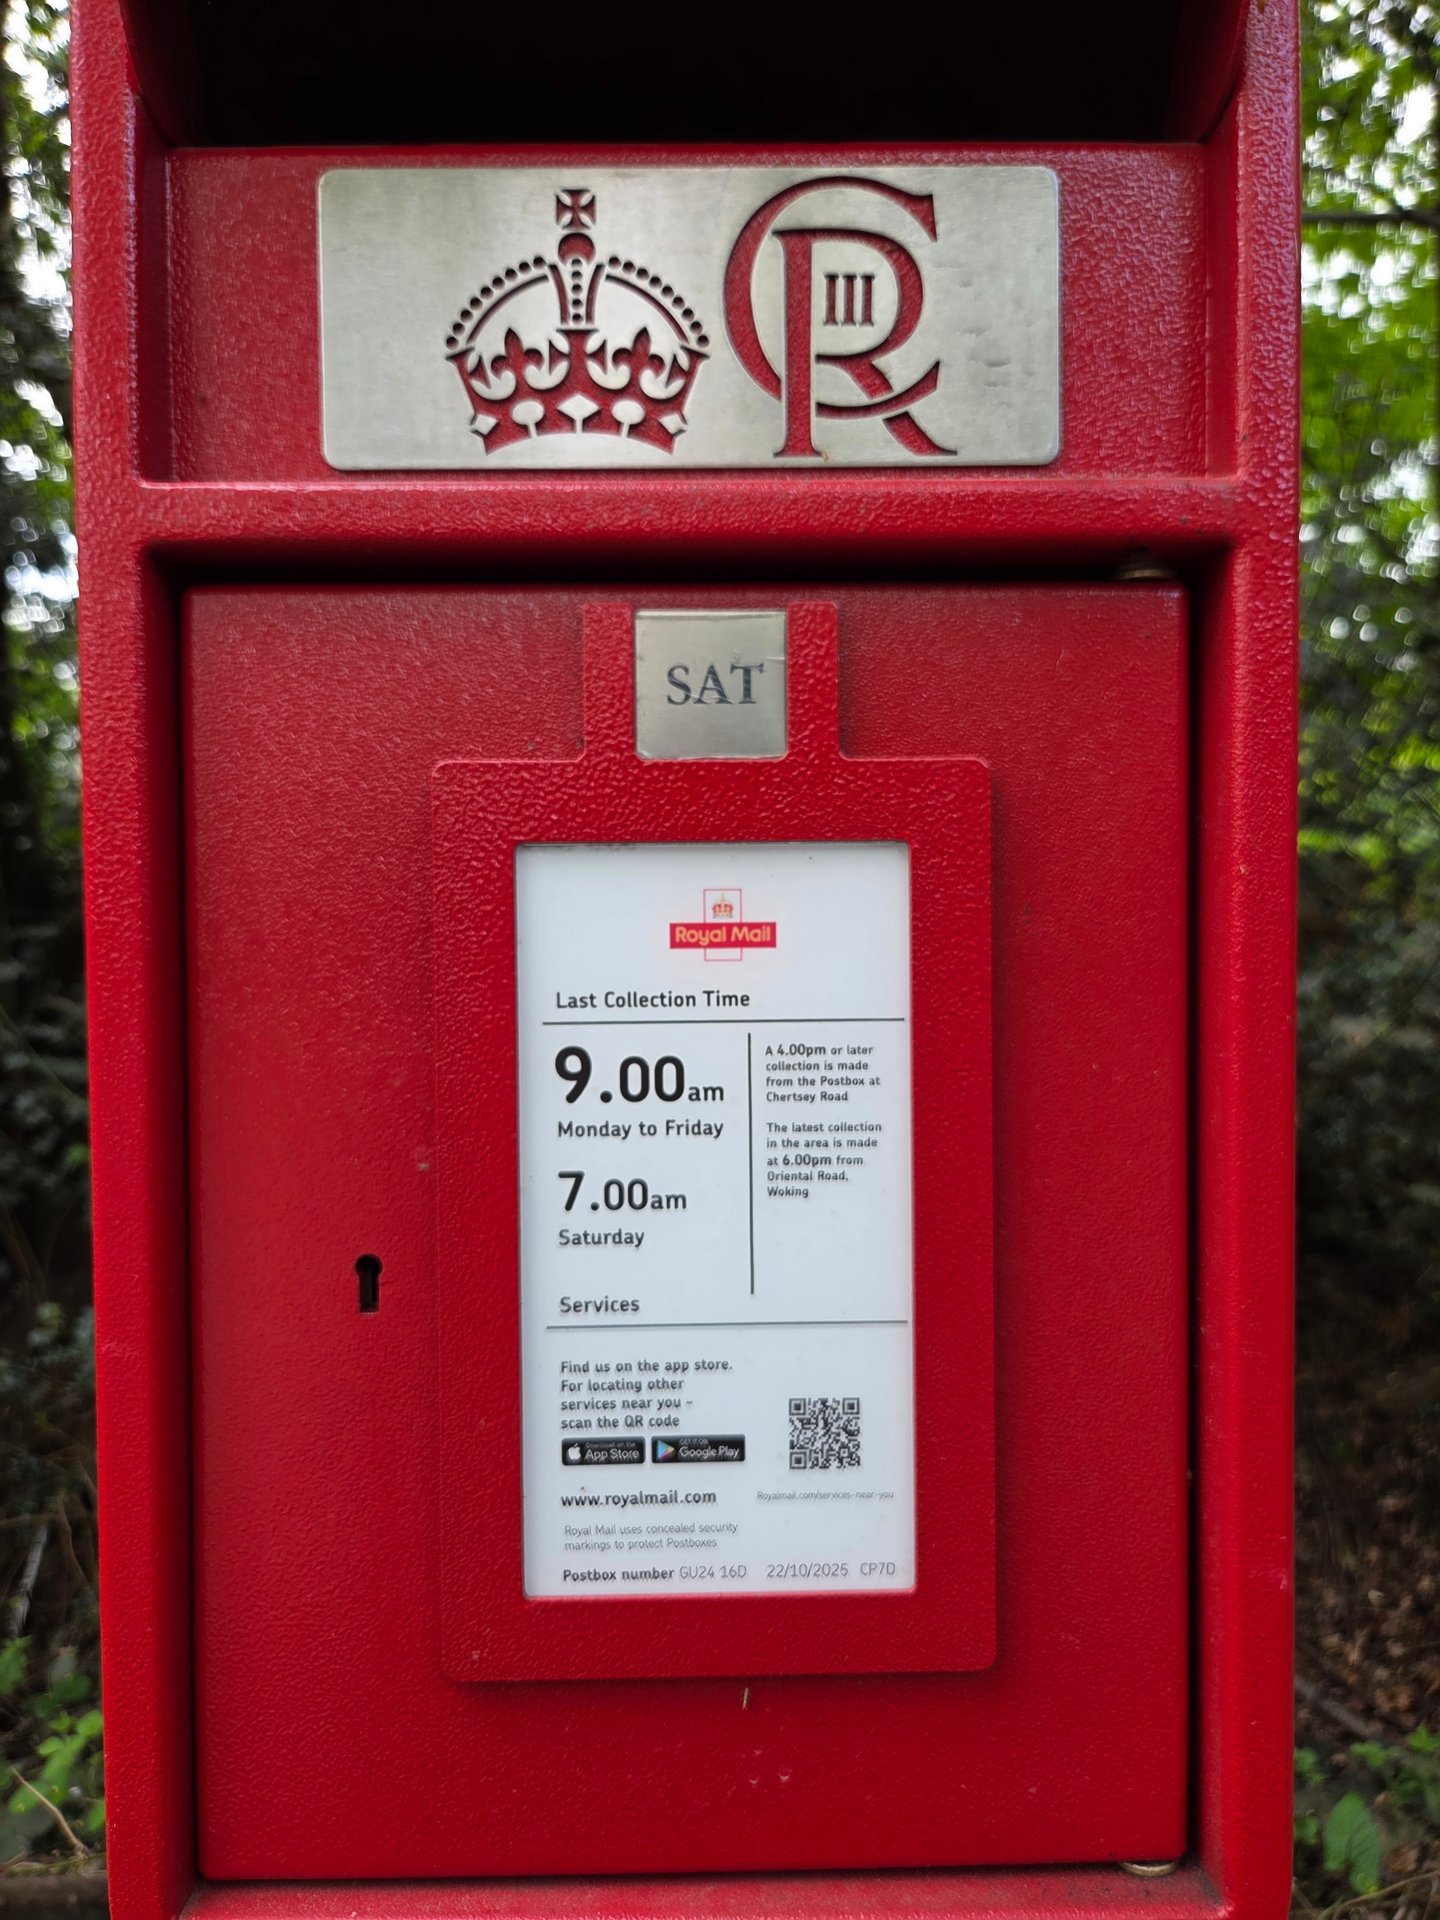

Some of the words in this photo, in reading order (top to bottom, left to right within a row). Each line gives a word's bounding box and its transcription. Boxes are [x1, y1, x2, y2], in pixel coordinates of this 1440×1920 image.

[666, 663, 764, 705] SAT
[675, 926, 727, 946] Royal
[731, 926, 771, 942] Mail
[557, 992, 597, 1008] Last
[605, 990, 696, 1008] Collection
[702, 990, 750, 1007] Time
[765, 1046, 773, 1056] A
[777, 1044, 826, 1057] 4.00pm
[831, 1046, 842, 1055] or
[847, 1045, 873, 1054] later
[766, 1062, 819, 1071] collection
[824, 1061, 833, 1070] is
[838, 1061, 868, 1070] made
[555, 1046, 724, 1103] 9.00am
[766, 1077, 793, 1086] from
[798, 1077, 815, 1086] the
[820, 1076, 864, 1085] Postbox
[869, 1077, 880, 1085] at
[766, 1092, 815, 1103] Chertsey
[820, 1091, 848, 1101] Road
[558, 1121, 632, 1140] Monday
[639, 1121, 657, 1136] to
[665, 1120, 723, 1138] Friday
[767, 1122, 787, 1132] The
[792, 1122, 824, 1132] latest
[828, 1121, 882, 1132] collection
[767, 1138, 777, 1148] in
[782, 1138, 799, 1148] the
[804, 1139, 828, 1147] area
[834, 1137, 842, 1147] is
[847, 1137, 877, 1147] made
[767, 1157, 778, 1166] at
[783, 1154, 831, 1167] 6.00pm
[836, 1155, 863, 1165] from
[768, 1171, 813, 1181] Oriental
[818, 1171, 848, 1182] Road,
[558, 1171, 687, 1212] 7.00am
[768, 1186, 808, 1198] Woking
[559, 1229, 645, 1248] Saturday
[560, 1297, 640, 1313] Services
[561, 1361, 590, 1373] Find
[596, 1362, 610, 1373] us
[616, 1362, 632, 1373] on
[638, 1361, 659, 1372] the
[665, 1361, 689, 1374] app
[695, 1360, 733, 1371] store.
[561, 1380, 583, 1392] For
[588, 1378, 642, 1393] locating
[648, 1378, 684, 1390] other
[561, 1398, 617, 1410] services
[622, 1398, 652, 1410] near
[658, 1398, 681, 1411] you
[561, 1418, 592, 1429] scan
[597, 1416, 619, 1428] the
[625, 1416, 644, 1428] QR
[649, 1415, 680, 1427] code
[585, 1449, 609, 1461] App
[611, 1448, 639, 1459] Store
[679, 1447, 716, 1459] Google
[719, 1446, 740, 1458] Play
[561, 1490, 717, 1507] www.royalmail.com
[564, 1526, 591, 1537] Royal
[595, 1525, 616, 1534] Mail
[620, 1526, 642, 1534] uses
[646, 1523, 695, 1534] concealed
[699, 1523, 737, 1534] security
[565, 1540, 611, 1551] markings
[628, 1539, 663, 1549] protect
[667, 1538, 717, 1547] Postboxes
[564, 1569, 616, 1581] Postbox
[622, 1568, 674, 1580] number
[680, 1566, 714, 1579] GU24
[721, 1565, 747, 1577] 16D
[767, 1562, 848, 1578] 22/10/2025
[860, 1562, 895, 1576] CP7D
